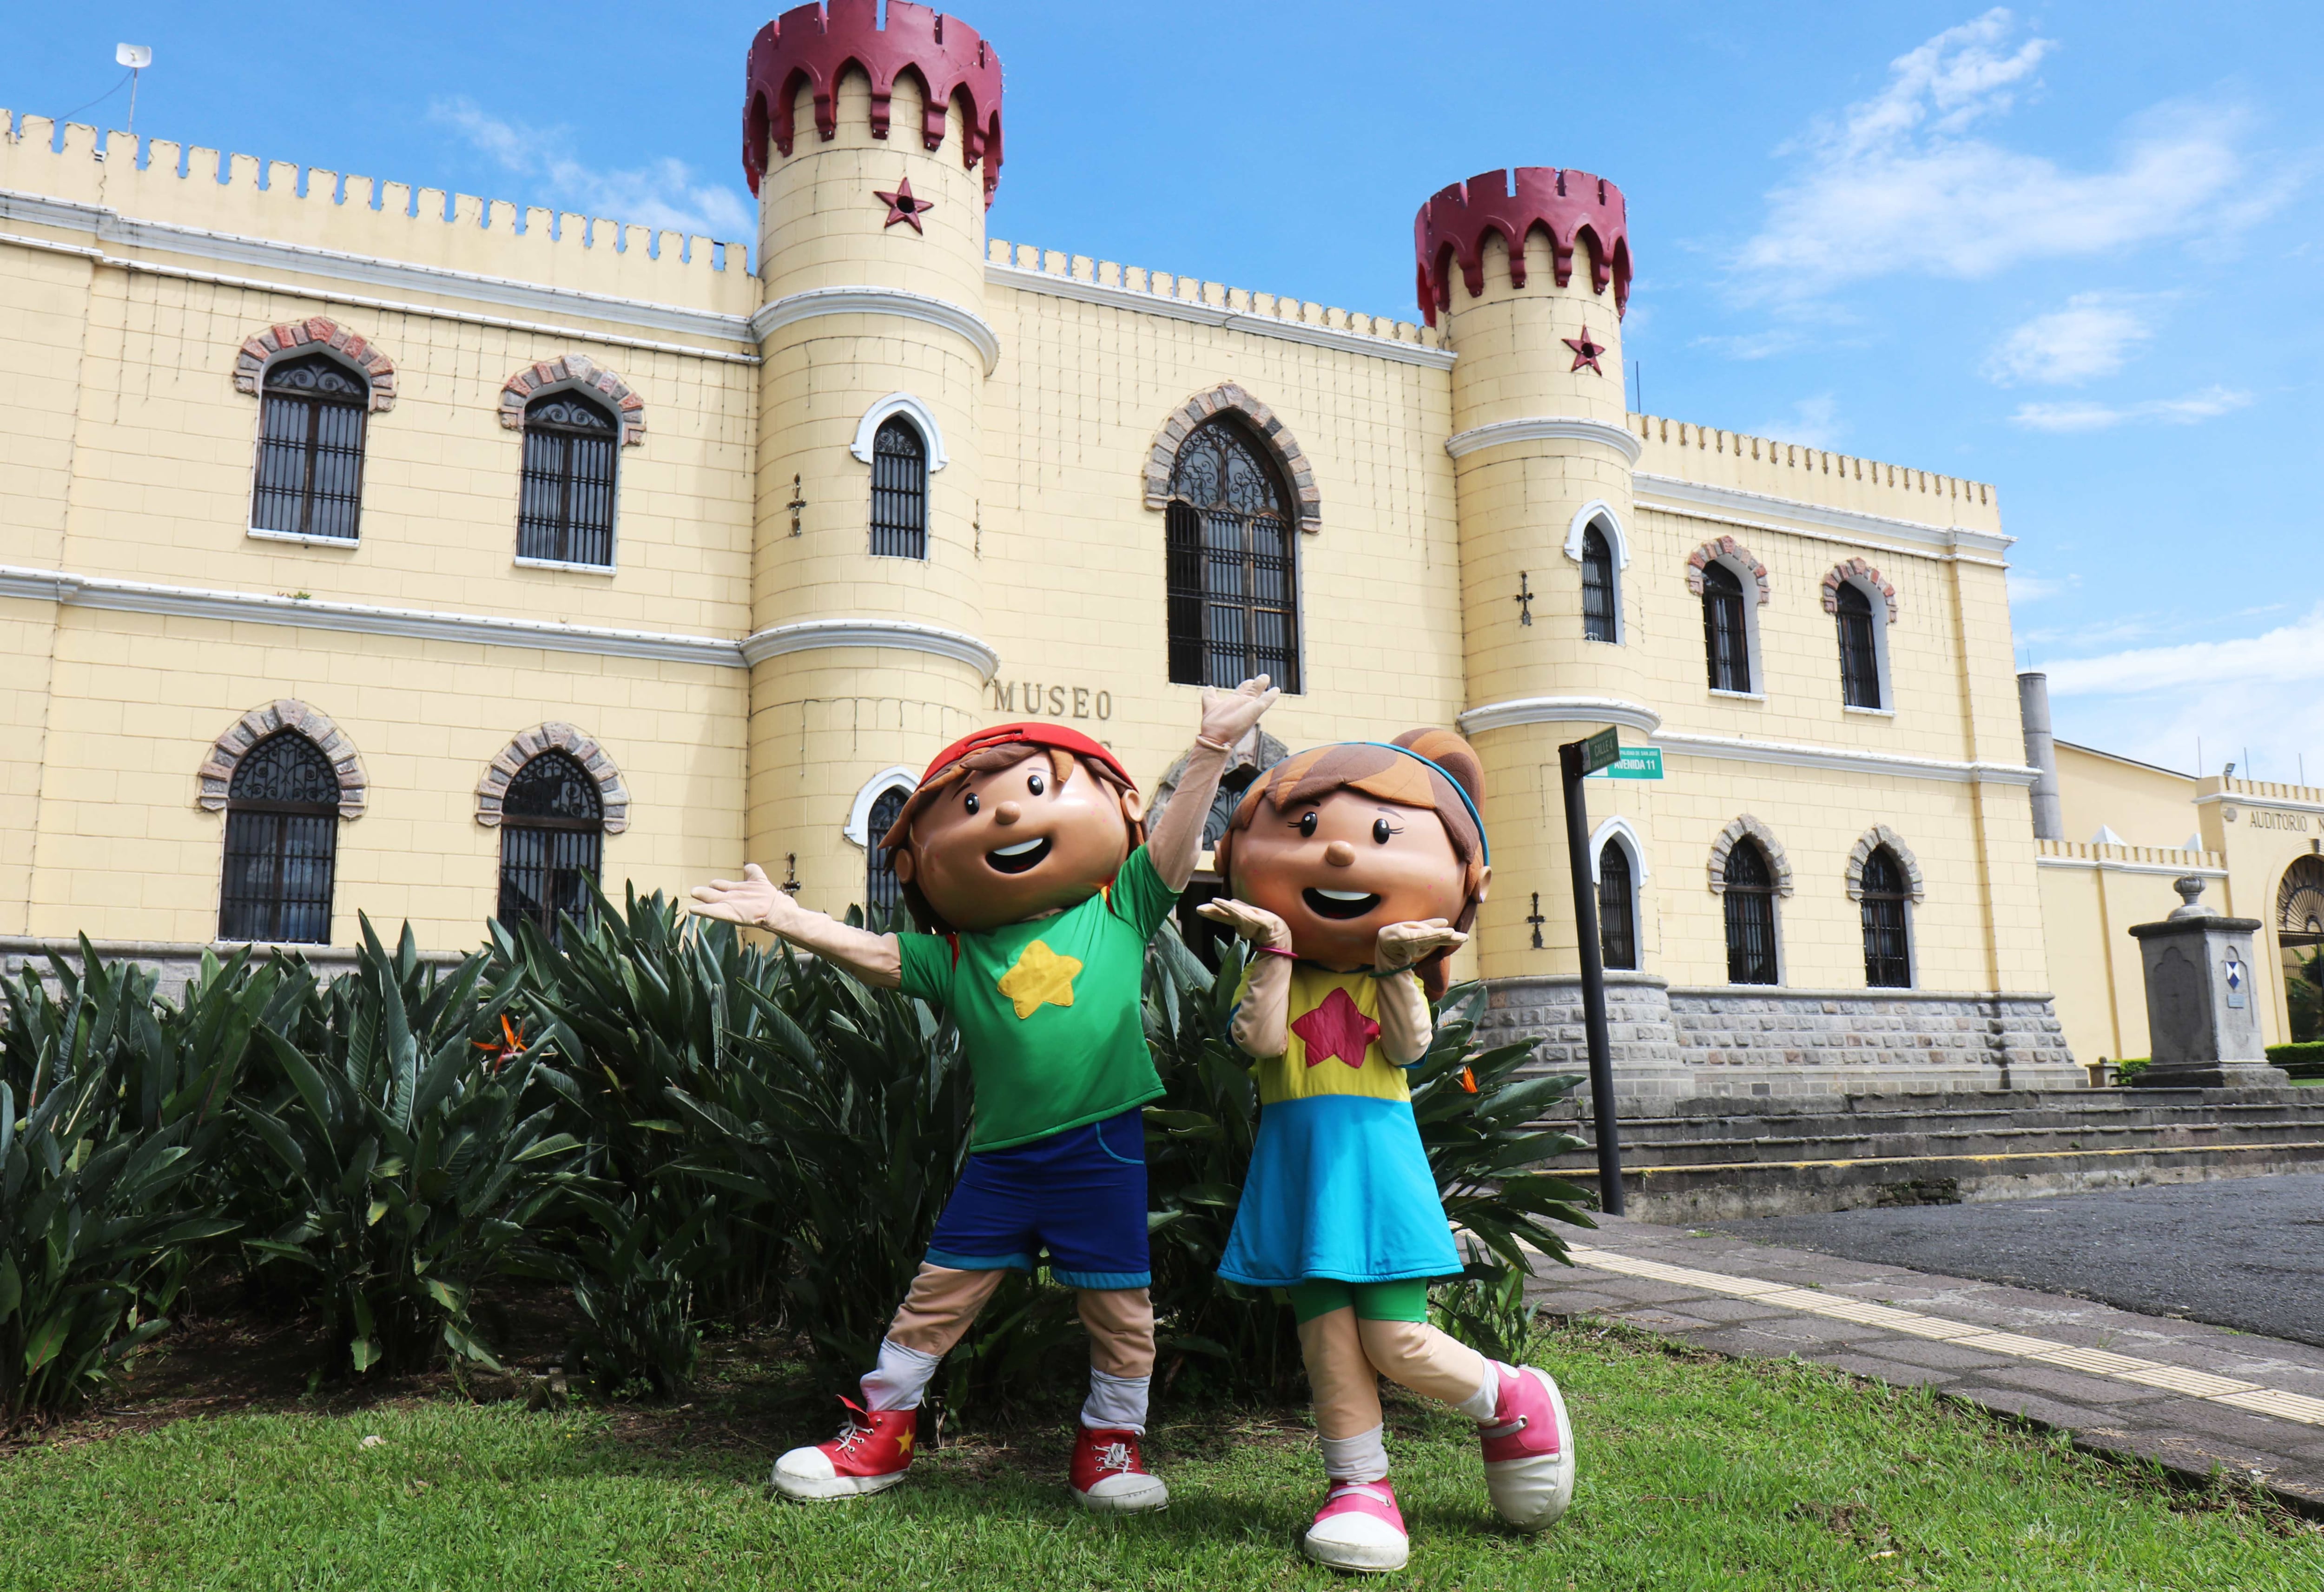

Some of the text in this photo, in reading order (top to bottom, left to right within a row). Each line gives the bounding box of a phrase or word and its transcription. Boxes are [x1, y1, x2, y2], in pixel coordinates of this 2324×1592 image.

[994, 679, 1111, 720] MUSEO
[1594, 740, 1609, 757] CALLE
[1614, 759, 1645, 770] AVENIDA
[1646, 759, 1655, 770] 11
[2250, 811, 2307, 832] AUDITORIO
